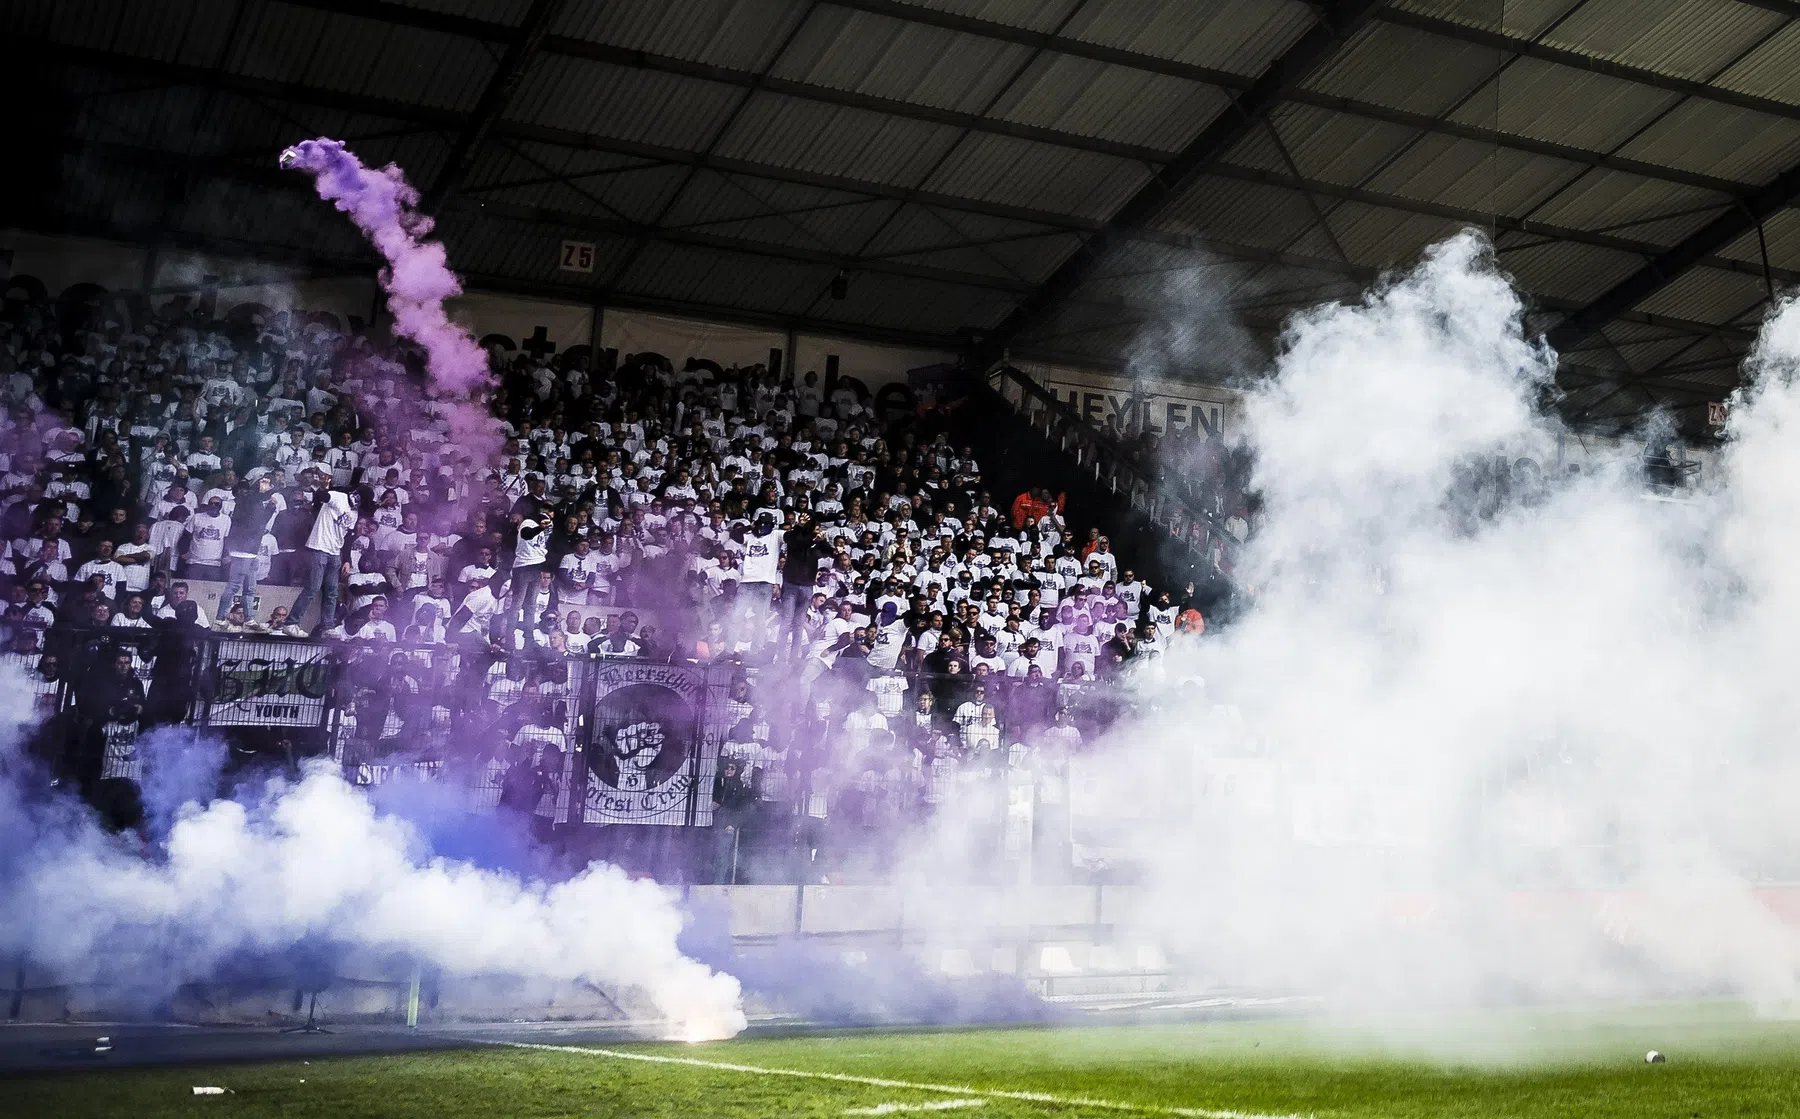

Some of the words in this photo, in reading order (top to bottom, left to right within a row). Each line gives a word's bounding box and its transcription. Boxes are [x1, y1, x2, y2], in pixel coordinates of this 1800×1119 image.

[563, 244, 592, 268] Z5
[255, 705, 299, 719] YOUTH
[641, 775, 690, 811] Crew
